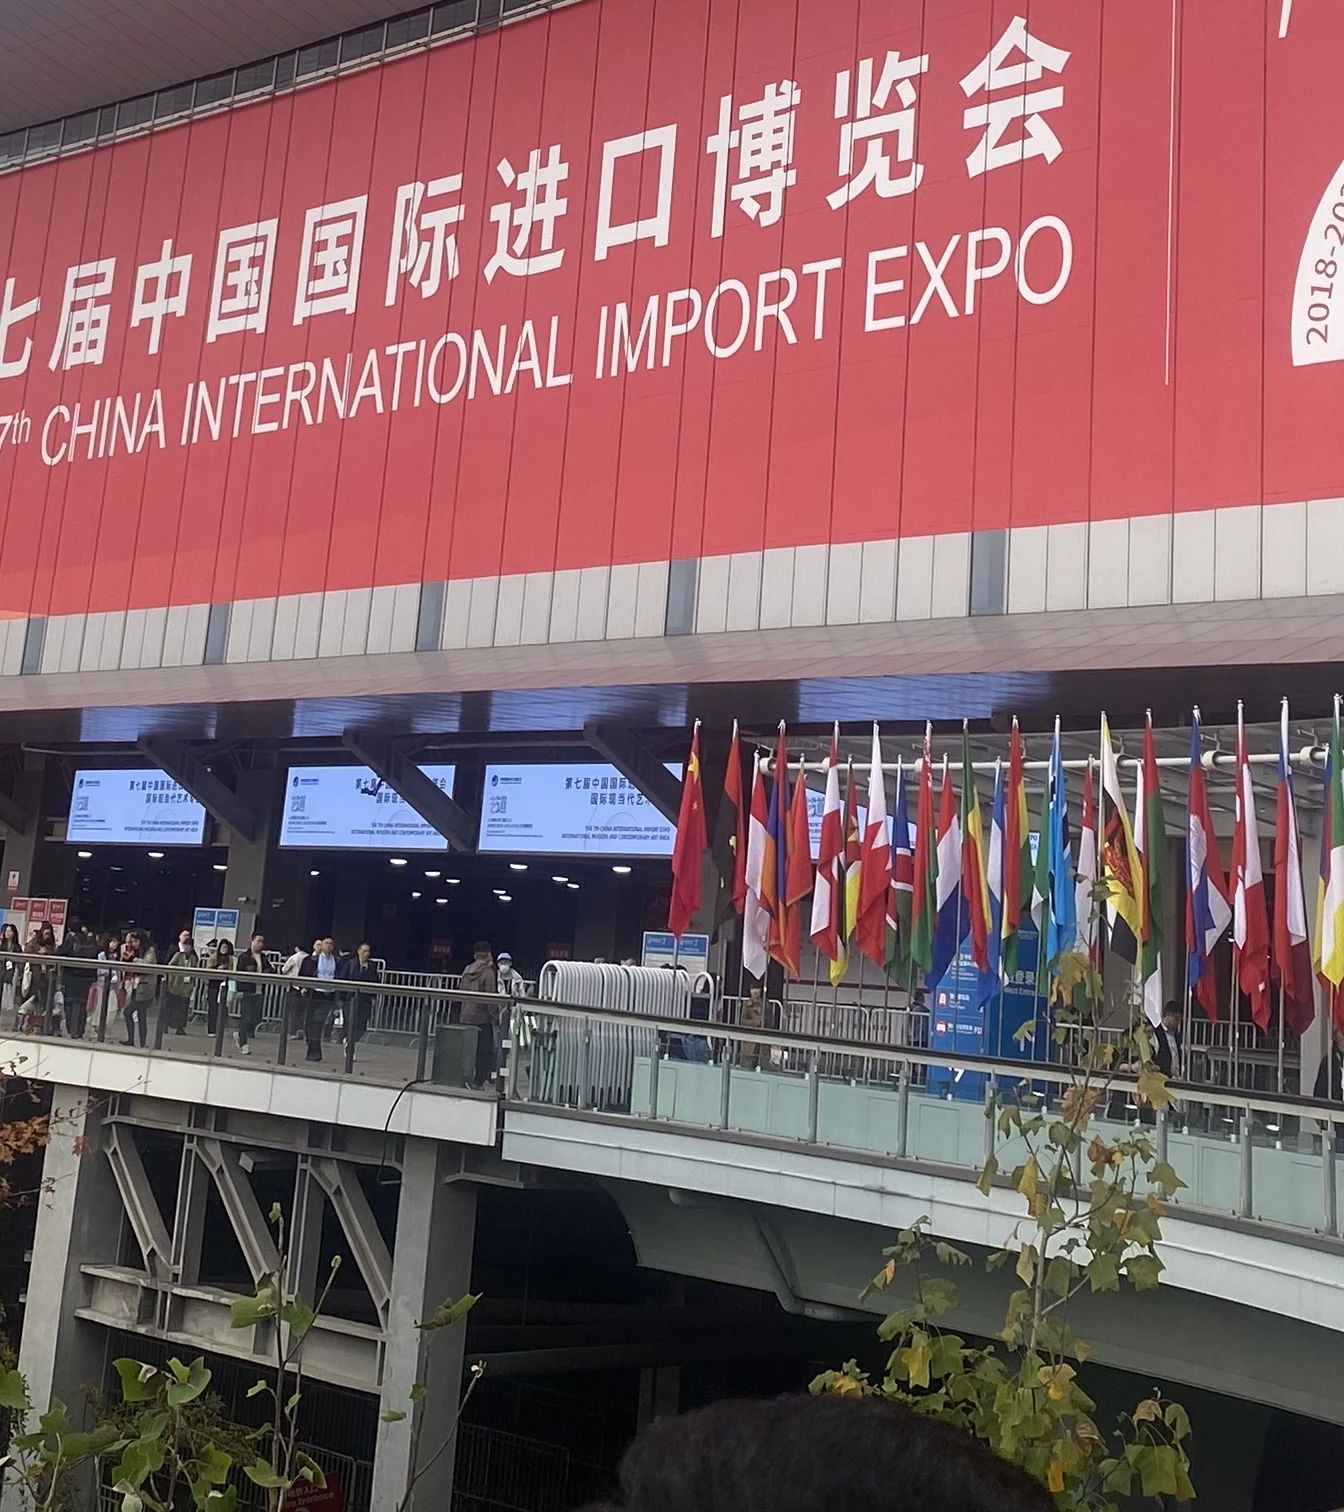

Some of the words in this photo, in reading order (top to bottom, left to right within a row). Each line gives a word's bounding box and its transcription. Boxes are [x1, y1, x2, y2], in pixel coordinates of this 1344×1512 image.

[41, 388, 167, 466] CHINA
[180, 315, 572, 446] INTERNATIONAL
[594, 257, 844, 380] IMPORT
[863, 214, 1074, 334] EXPO
